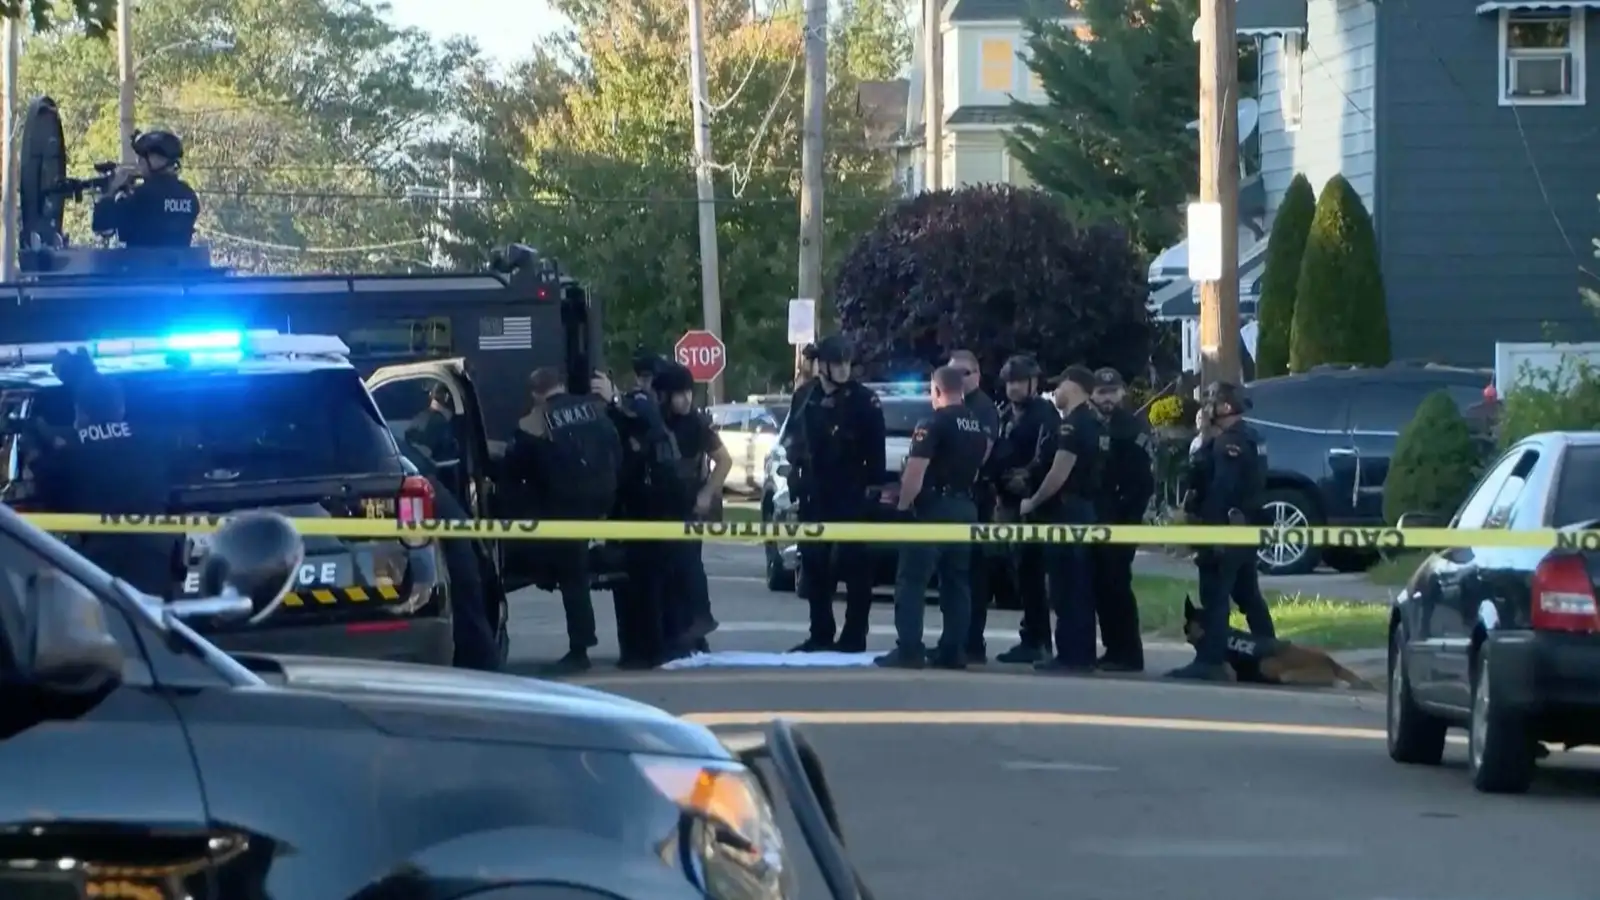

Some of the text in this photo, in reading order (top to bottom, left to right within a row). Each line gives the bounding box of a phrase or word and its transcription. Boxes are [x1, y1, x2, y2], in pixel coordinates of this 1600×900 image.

[164, 198, 192, 213] POLICE
[679, 346, 721, 367] STOP
[79, 421, 132, 444] POLICE
[957, 417, 981, 433] POLICE
[684, 521, 825, 537] CAUTION
[970, 524, 1112, 542] CAUTION
[1259, 528, 1405, 547] CAUTION
[1227, 635, 1256, 656] LICE
